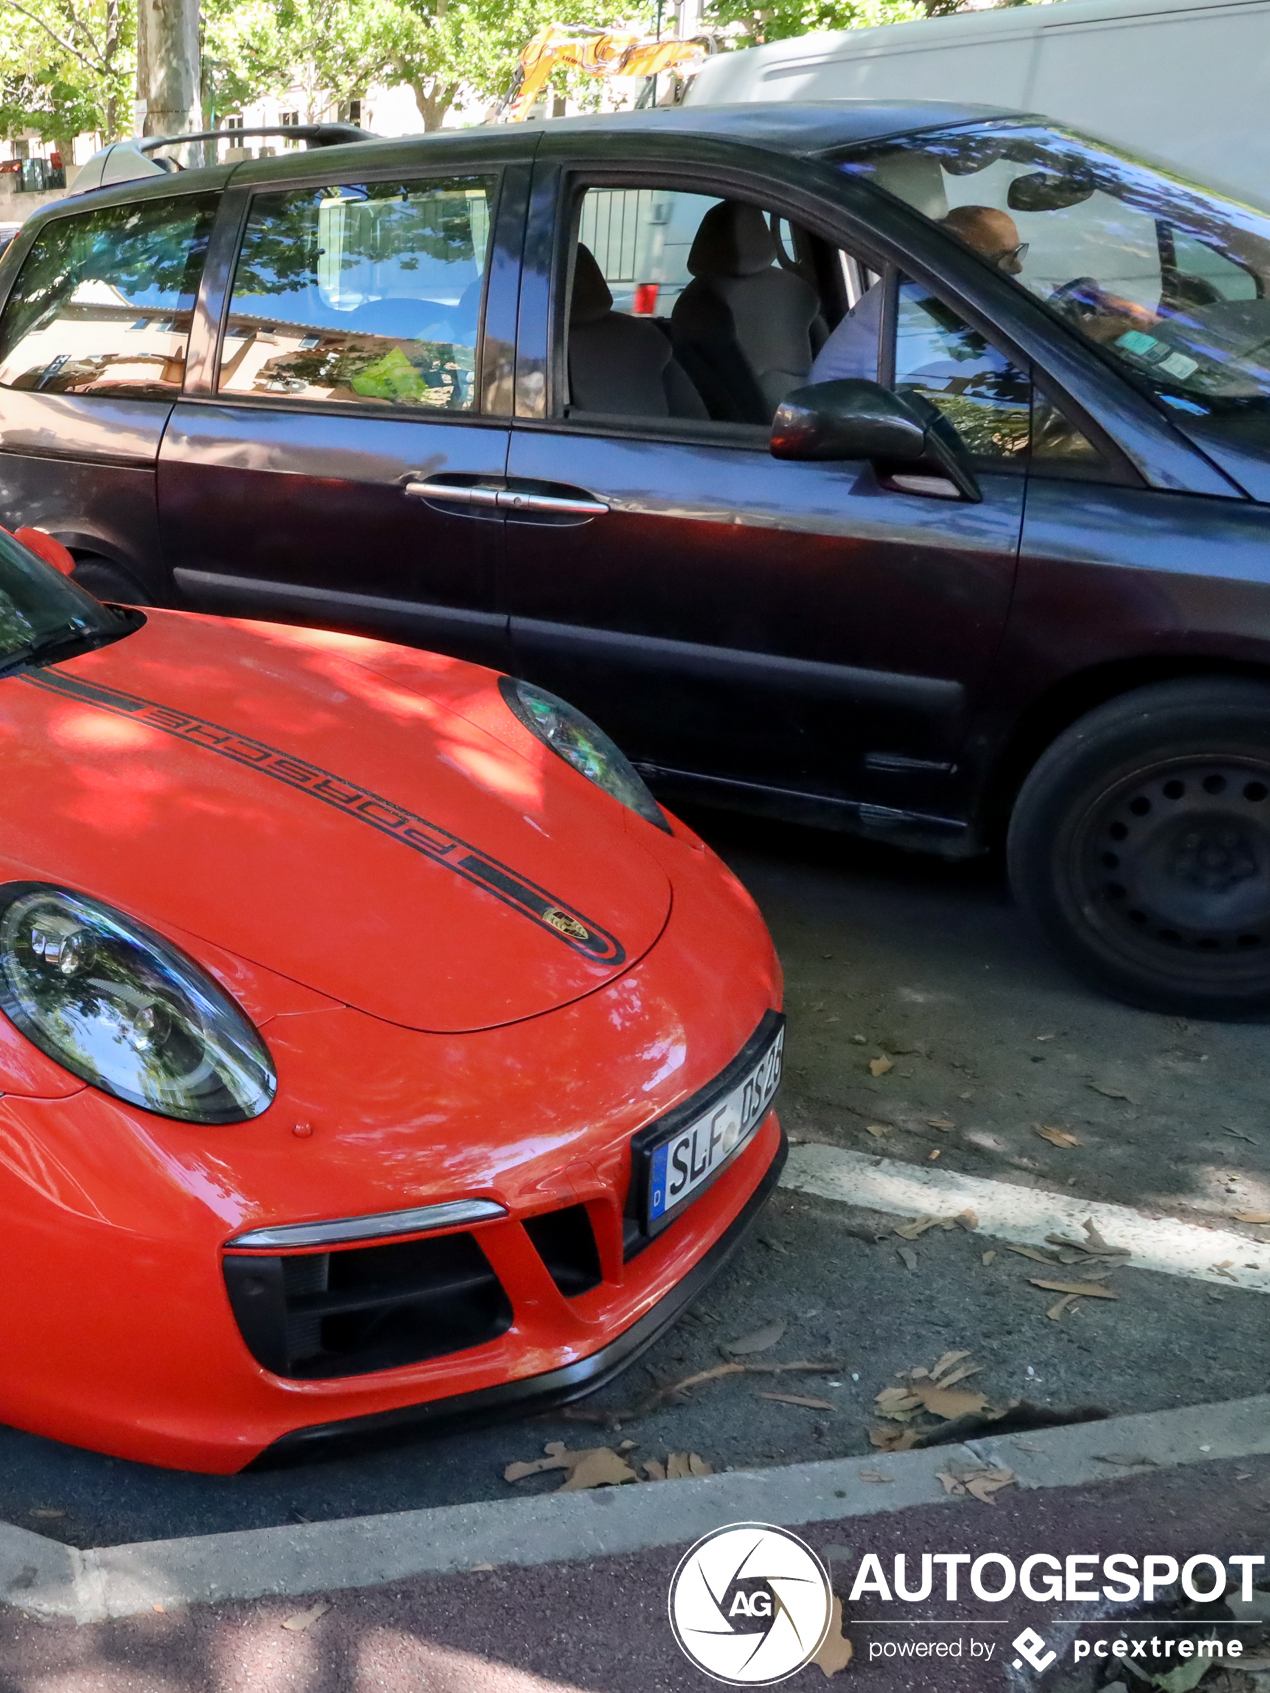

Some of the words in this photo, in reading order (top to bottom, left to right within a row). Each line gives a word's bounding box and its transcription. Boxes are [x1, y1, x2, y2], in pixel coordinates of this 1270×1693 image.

[143, 708, 458, 855] PORSCHE
[669, 1104, 727, 1196] SLF
[653, 1190, 661, 1208] D
